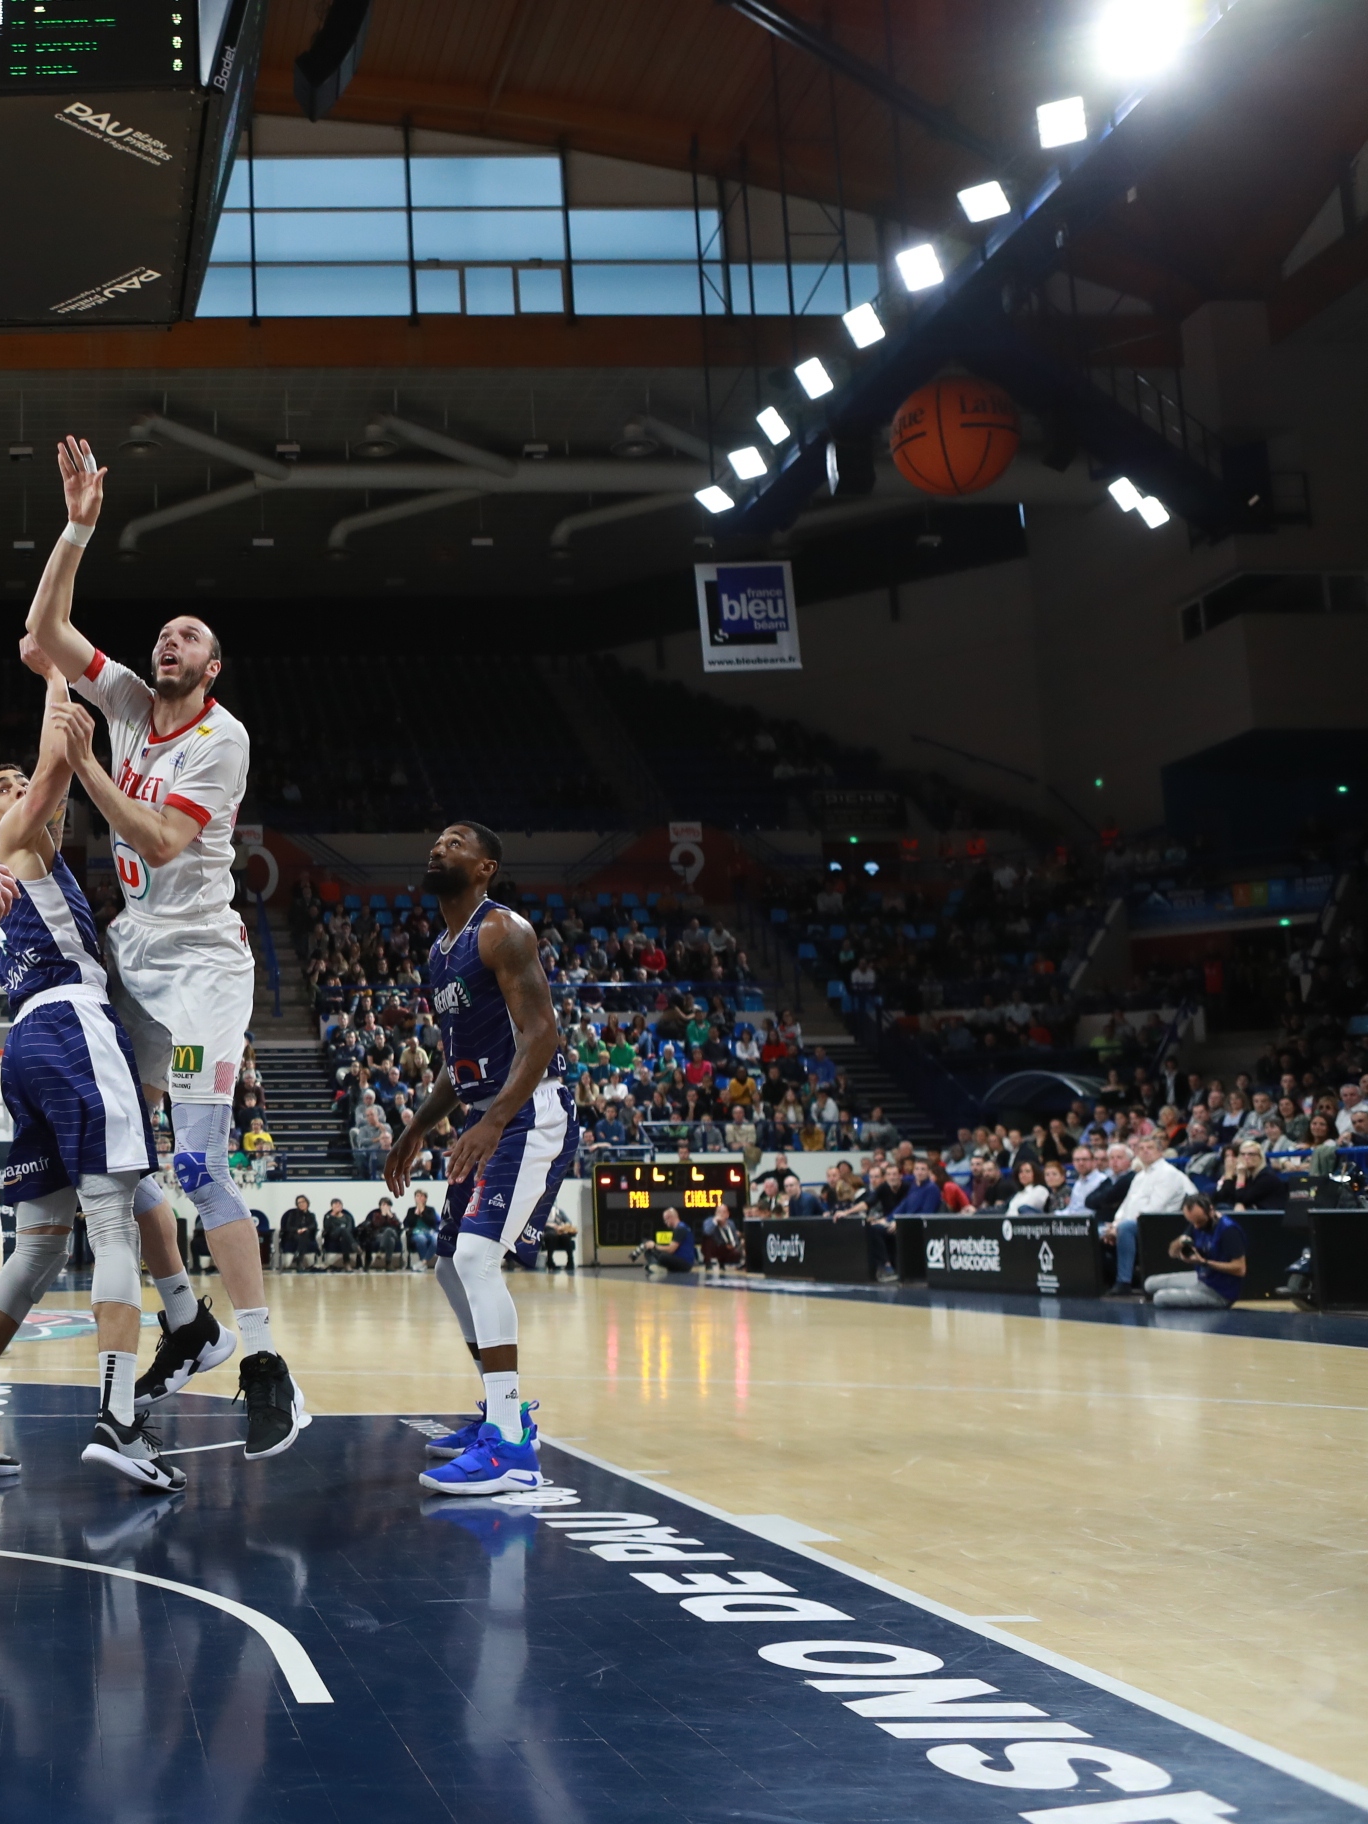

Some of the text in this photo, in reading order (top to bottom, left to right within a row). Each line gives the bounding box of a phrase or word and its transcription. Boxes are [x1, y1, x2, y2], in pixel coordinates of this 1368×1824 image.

[213, 45, 236, 93] Bodet
[54, 113, 102, 140] Communauté
[65, 102, 133, 137] PAU
[123, 135, 173, 161] PYRÉNÉES
[132, 131, 168, 149] BÉARN
[103, 269, 162, 298] PAU
[747, 587, 783, 598] france
[721, 593, 786, 621] bleu
[754, 620, 787, 630] béarn
[669, 841, 705, 885] 9
[488, 1199, 506, 1209] PEAK
[684, 1190, 723, 1208] CHOLET
[949, 1236, 1000, 1256] PYRÉNÉES
[949, 1255, 1002, 1272] GASCOGNE
[530, 1511, 1240, 1824] SINO DE PAU
